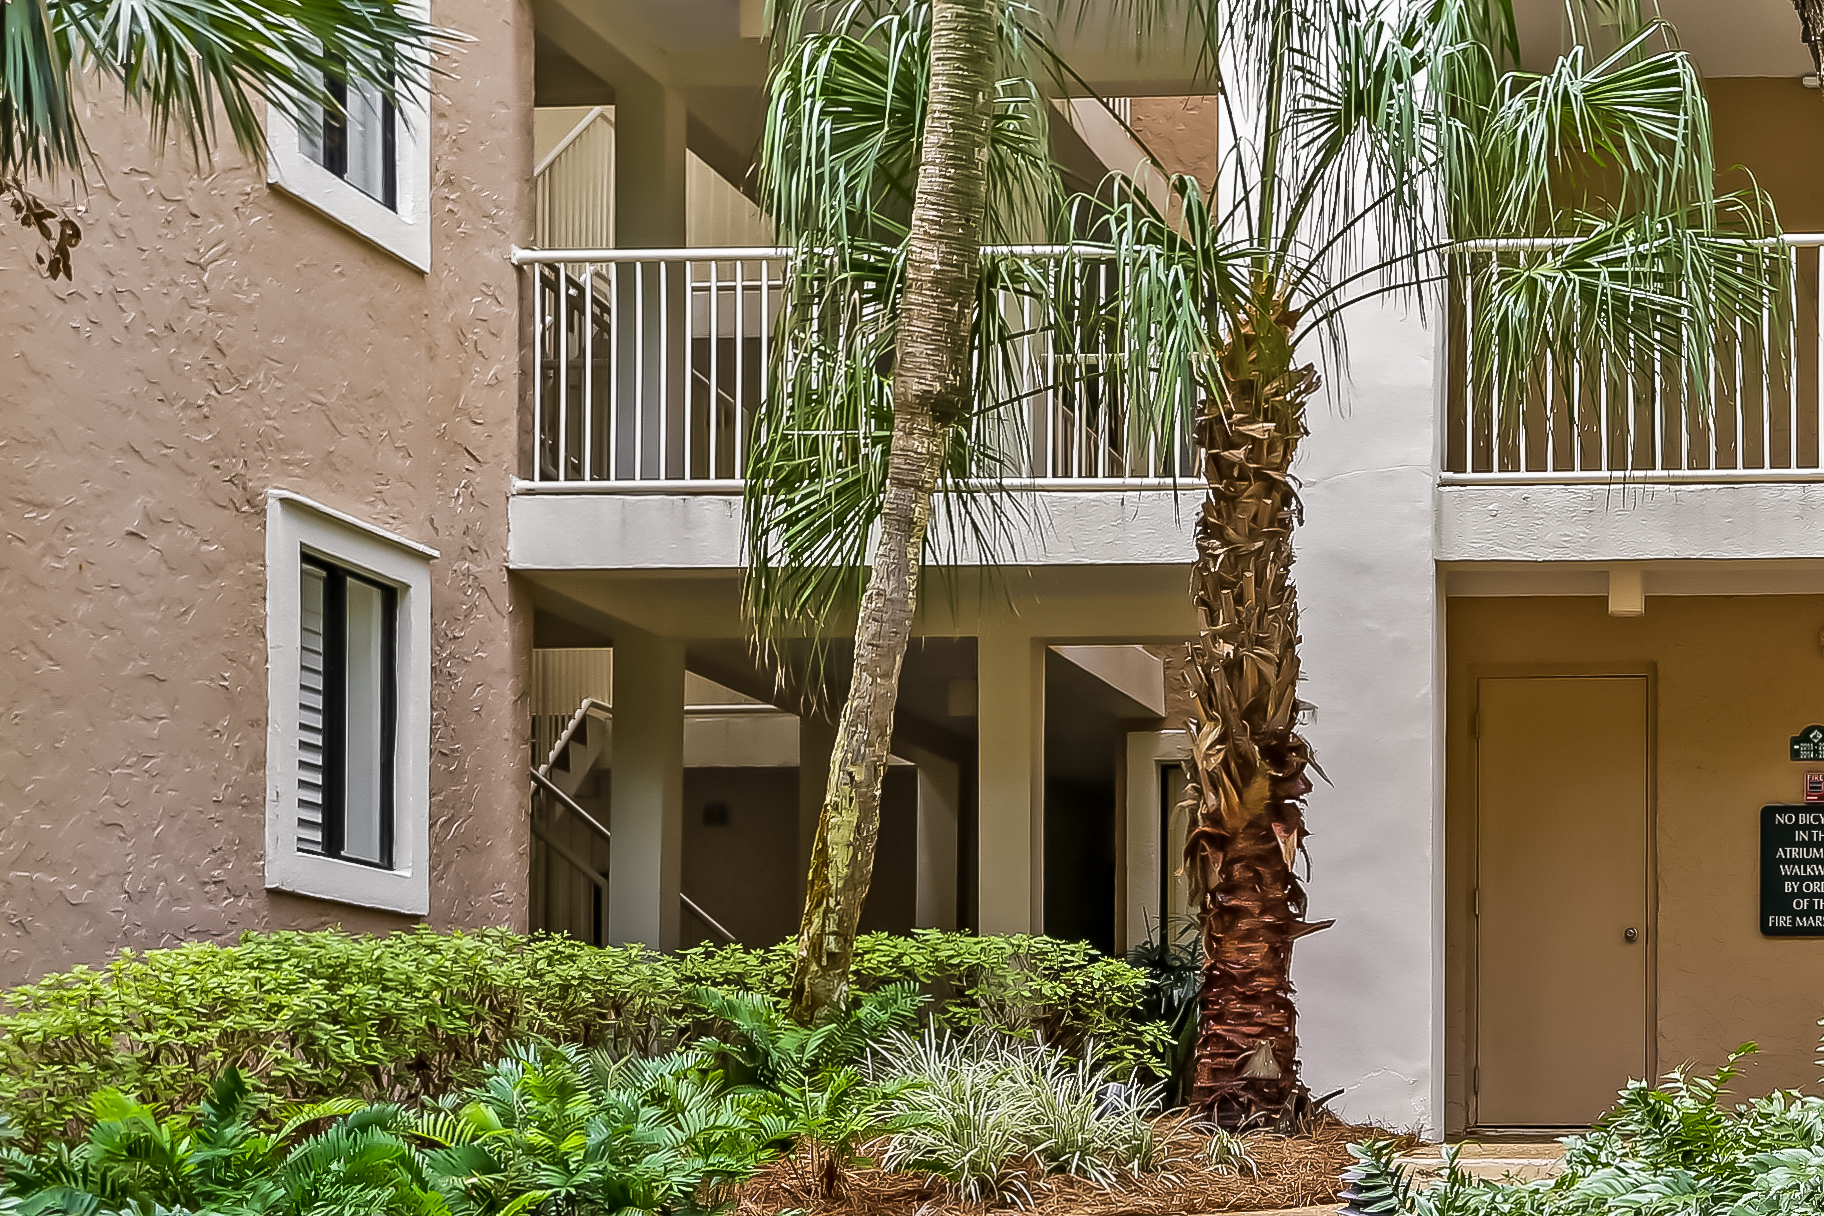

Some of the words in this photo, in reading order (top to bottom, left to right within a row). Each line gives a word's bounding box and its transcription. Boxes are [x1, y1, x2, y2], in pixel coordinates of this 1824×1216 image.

[1807, 774, 1823, 782] FIRE
[1775, 813, 1795, 825] NO
[1795, 830, 1809, 842] IN
[1784, 881, 1799, 893] BY
[1792, 898, 1810, 910] OF
[1768, 915, 1793, 928] FIRE
